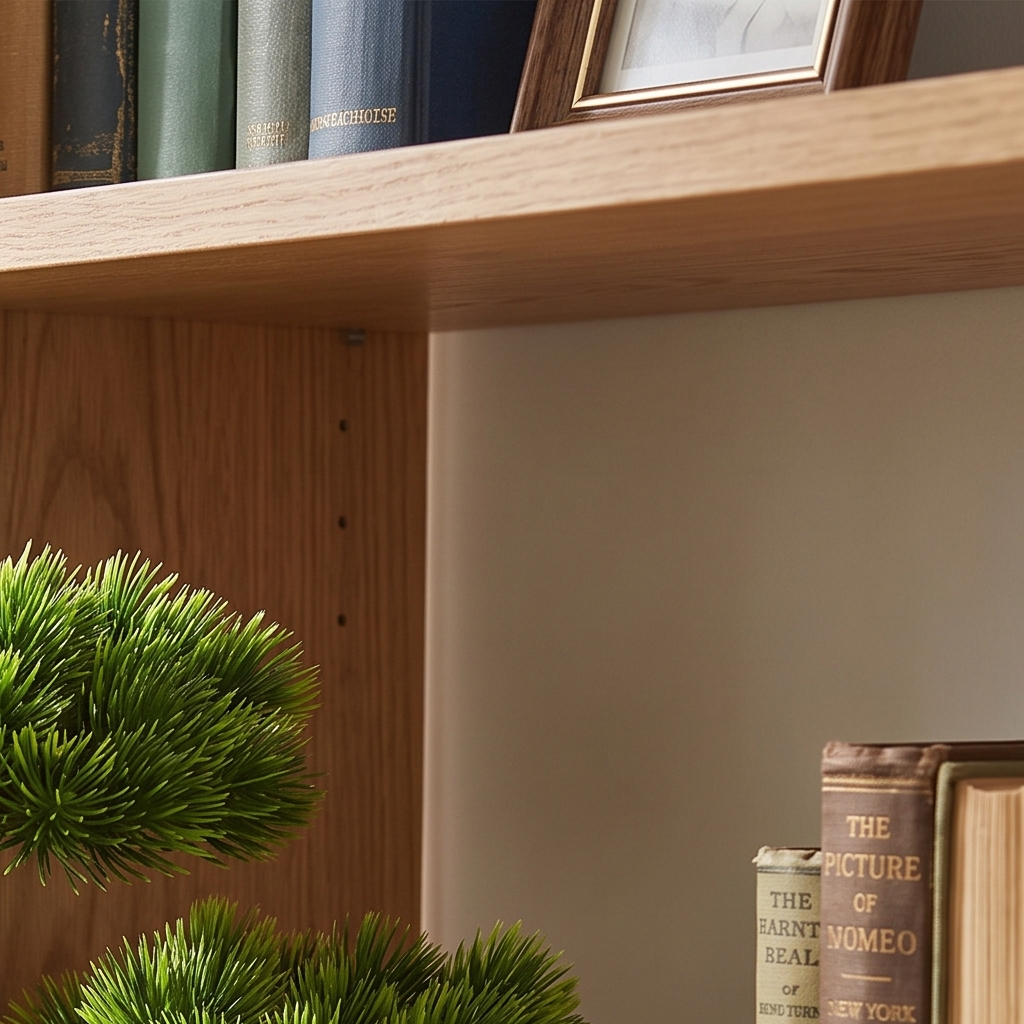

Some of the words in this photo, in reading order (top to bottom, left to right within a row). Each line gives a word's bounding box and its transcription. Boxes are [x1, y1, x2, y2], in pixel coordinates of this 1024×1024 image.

[846, 815, 892, 839] THE
[824, 851, 922, 882] PICTURE
[769, 891, 813, 910] THE
[852, 892, 878, 913] OF
[826, 925, 918, 956] NOMEO
[764, 946, 820, 967] BEAL
[827, 1000, 864, 1019] NEW
[865, 1002, 917, 1023] YORK
